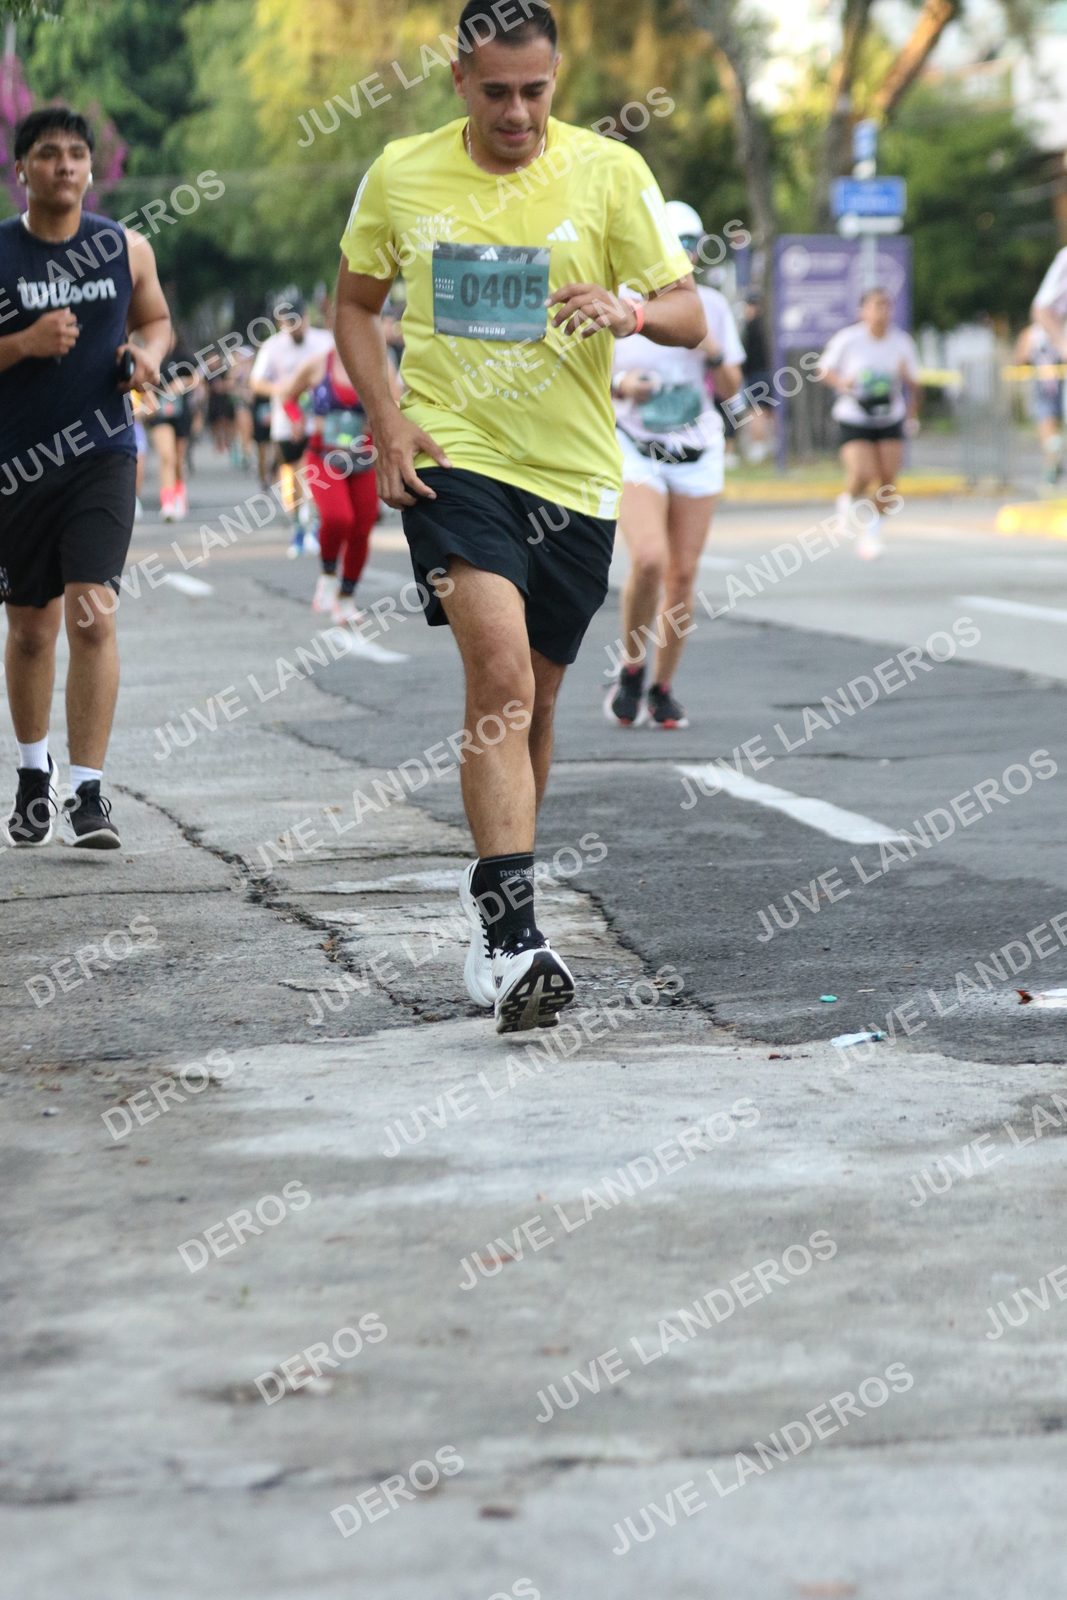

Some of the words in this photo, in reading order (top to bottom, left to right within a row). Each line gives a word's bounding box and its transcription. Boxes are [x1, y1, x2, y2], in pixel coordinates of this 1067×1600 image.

[17, 277, 117, 311] Wilson
[460, 273, 544, 310] 0405
[468, 325, 506, 335] SAMSUNG
